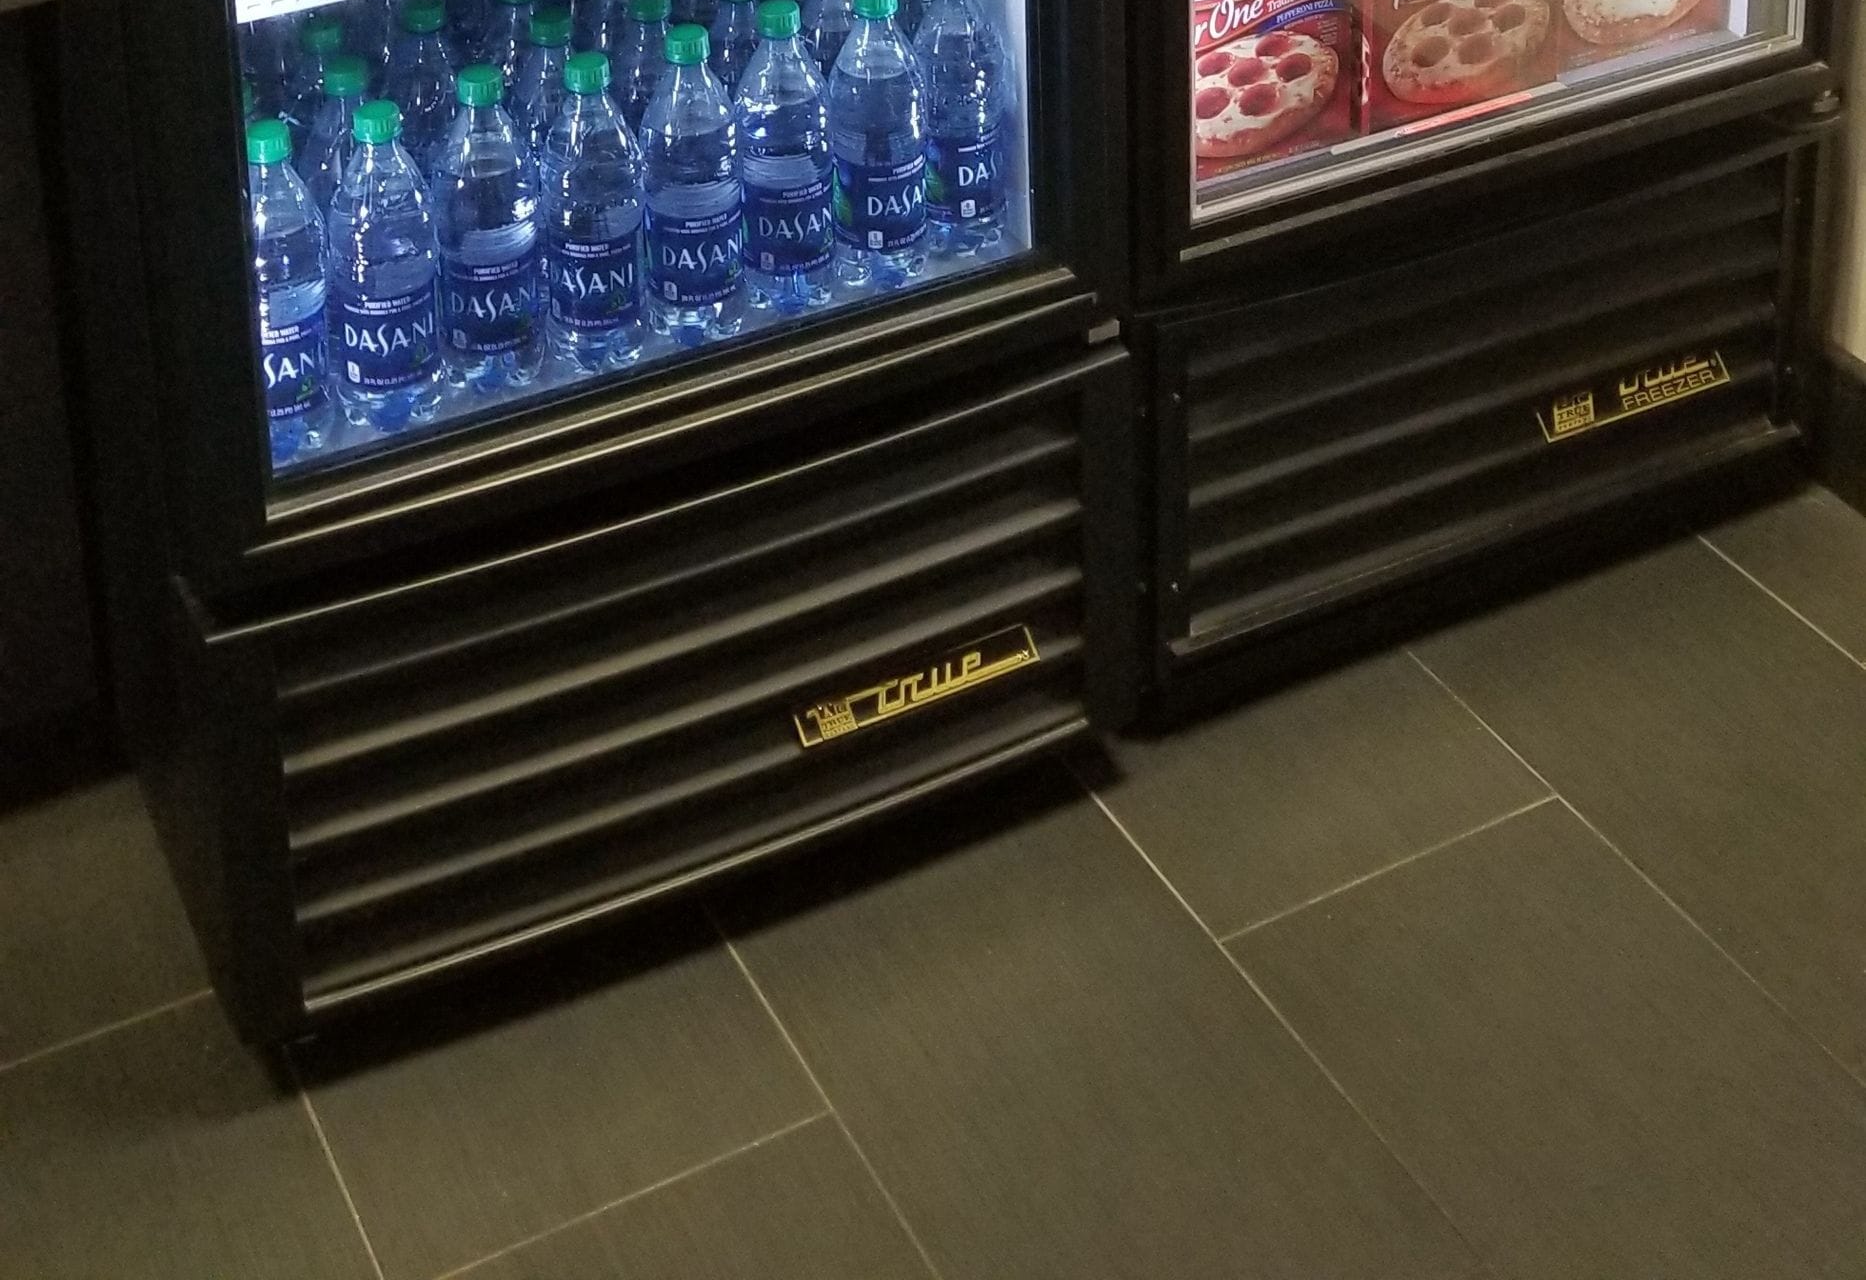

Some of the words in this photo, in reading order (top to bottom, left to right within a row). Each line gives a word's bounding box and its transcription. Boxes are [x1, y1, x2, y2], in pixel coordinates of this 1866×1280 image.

[1276, 2, 1313, 24] PEPPERONI
[1314, 0, 1334, 10] PIZZA
[958, 151, 1002, 187] DAS
[759, 203, 832, 243] DASAN
[473, 267, 501, 275] PURIFIED
[662, 228, 743, 274] DASANI
[451, 277, 536, 322] DASANI
[344, 311, 434, 358] DASANI
[263, 347, 318, 390] SAN
[1622, 369, 1716, 411] FREEZER
[1557, 402, 1591, 421] TRUE
